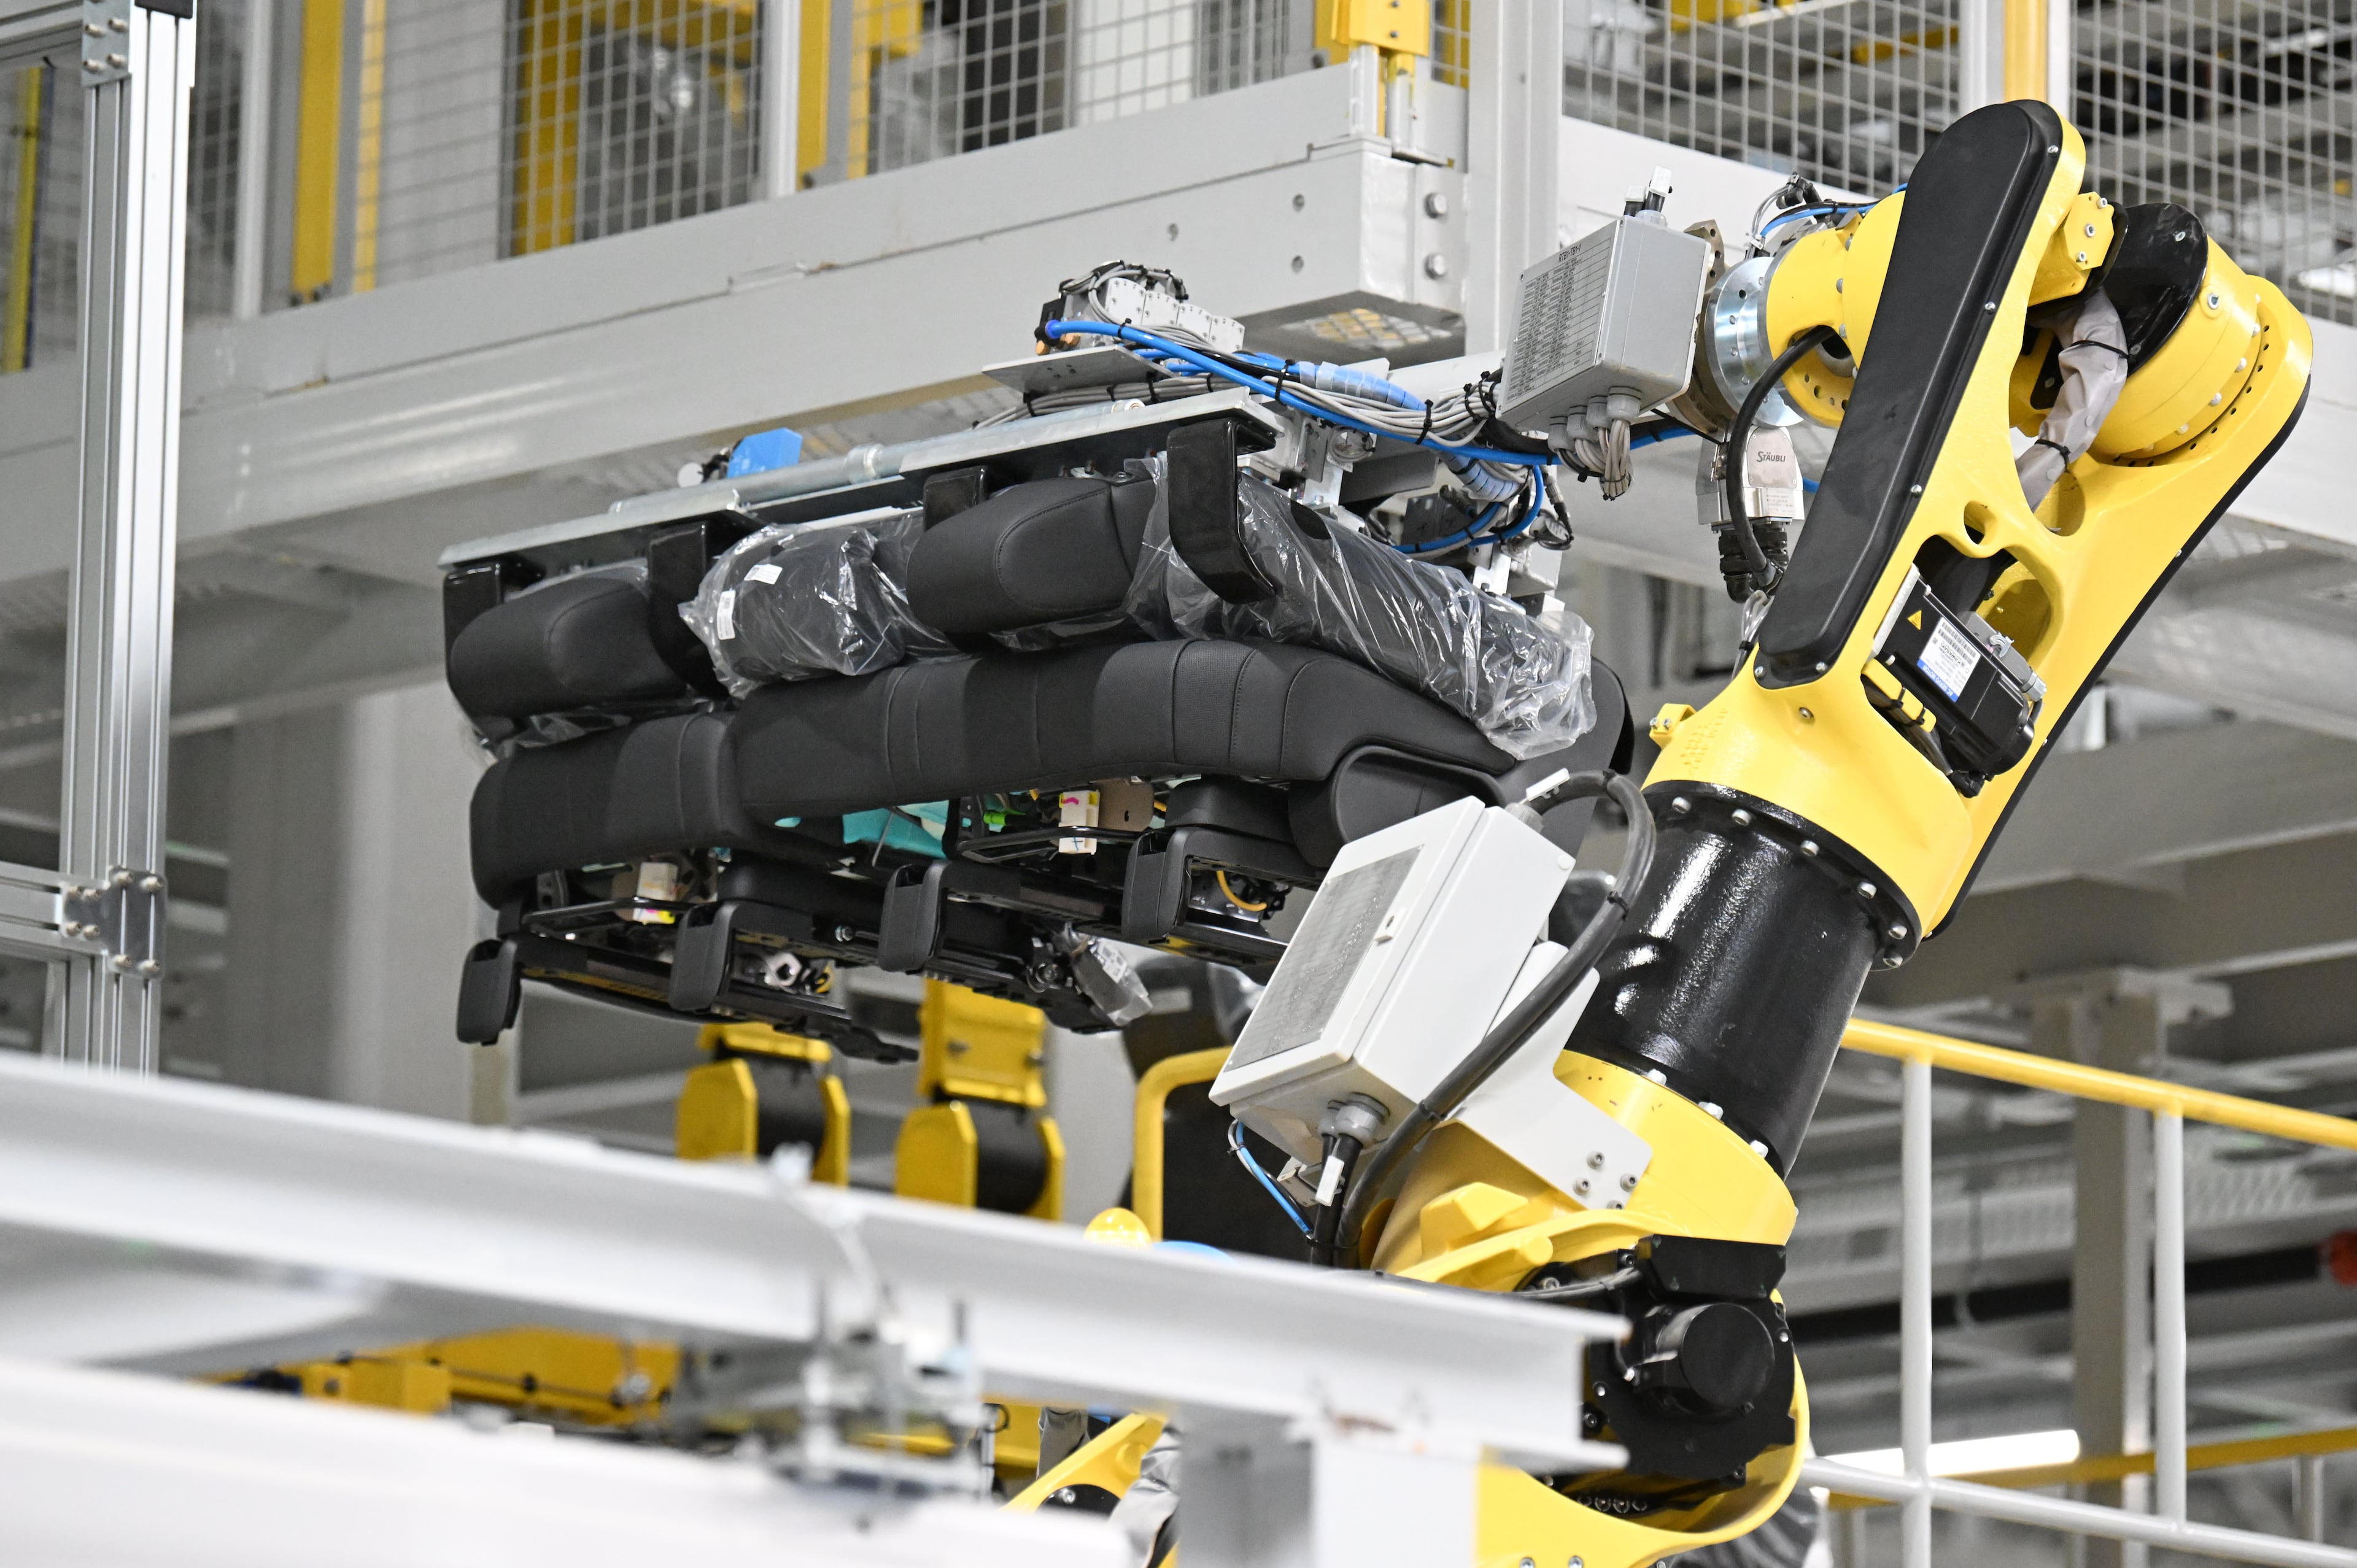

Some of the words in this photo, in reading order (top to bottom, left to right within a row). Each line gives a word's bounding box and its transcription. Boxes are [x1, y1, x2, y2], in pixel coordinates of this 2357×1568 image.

[1940, 643, 1960, 664] KAWASAKI
[1922, 664, 1937, 679] MOTOR
[1934, 676, 1948, 692] SERVO
[1945, 688, 1953, 697] AC
